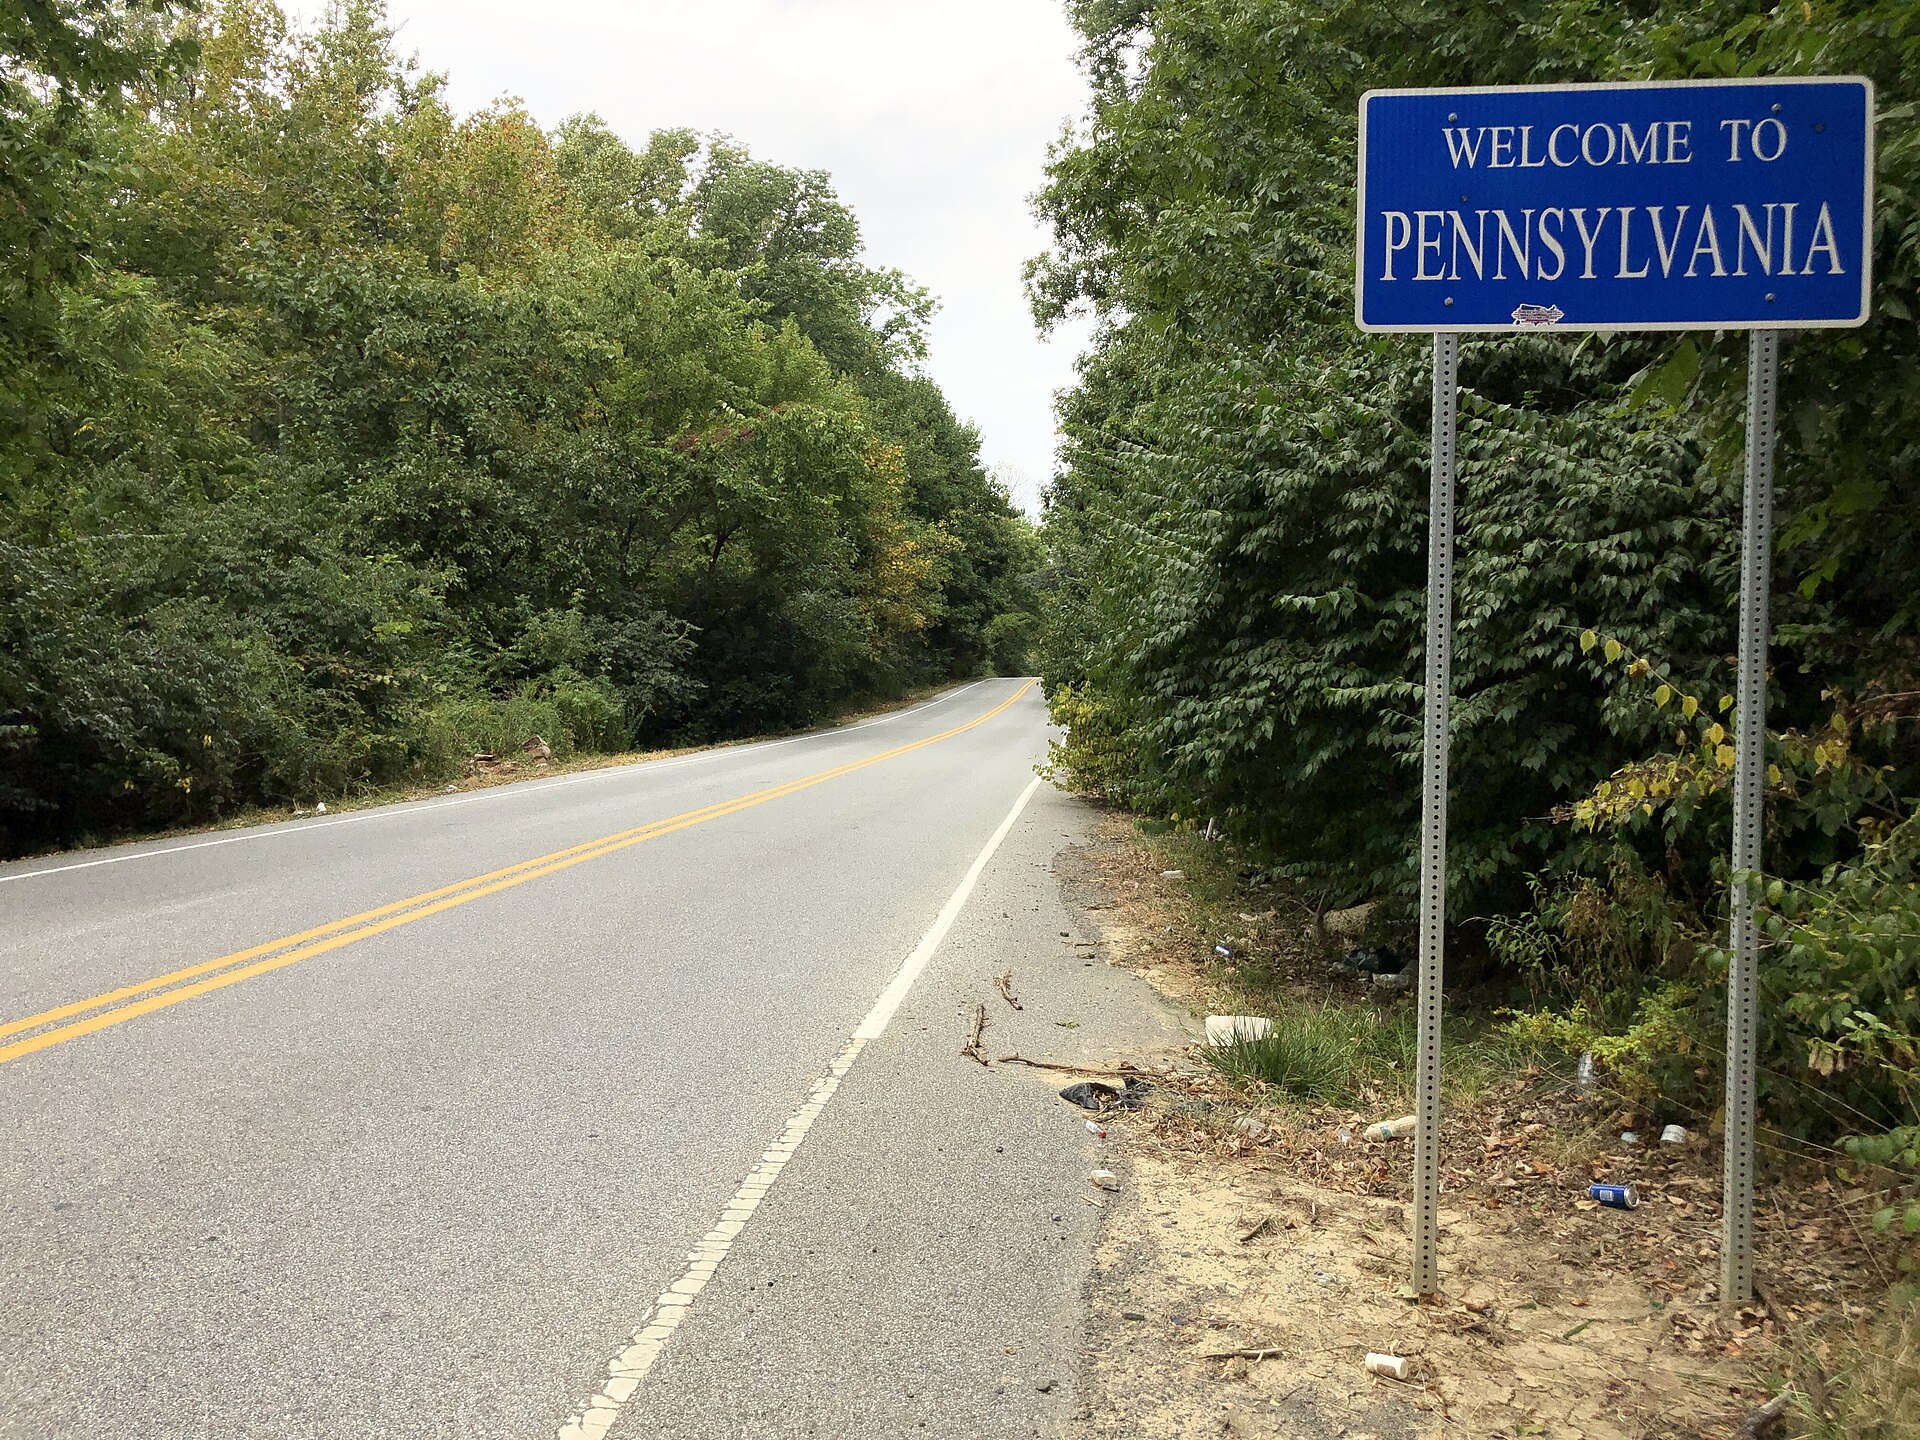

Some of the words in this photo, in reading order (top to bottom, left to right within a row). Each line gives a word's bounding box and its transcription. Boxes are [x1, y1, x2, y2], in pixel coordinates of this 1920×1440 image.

[1442, 121, 1692, 169] WELCOME
[1720, 117, 1787, 162] TO
[1380, 202, 1845, 281] PENNSYLVANIA
